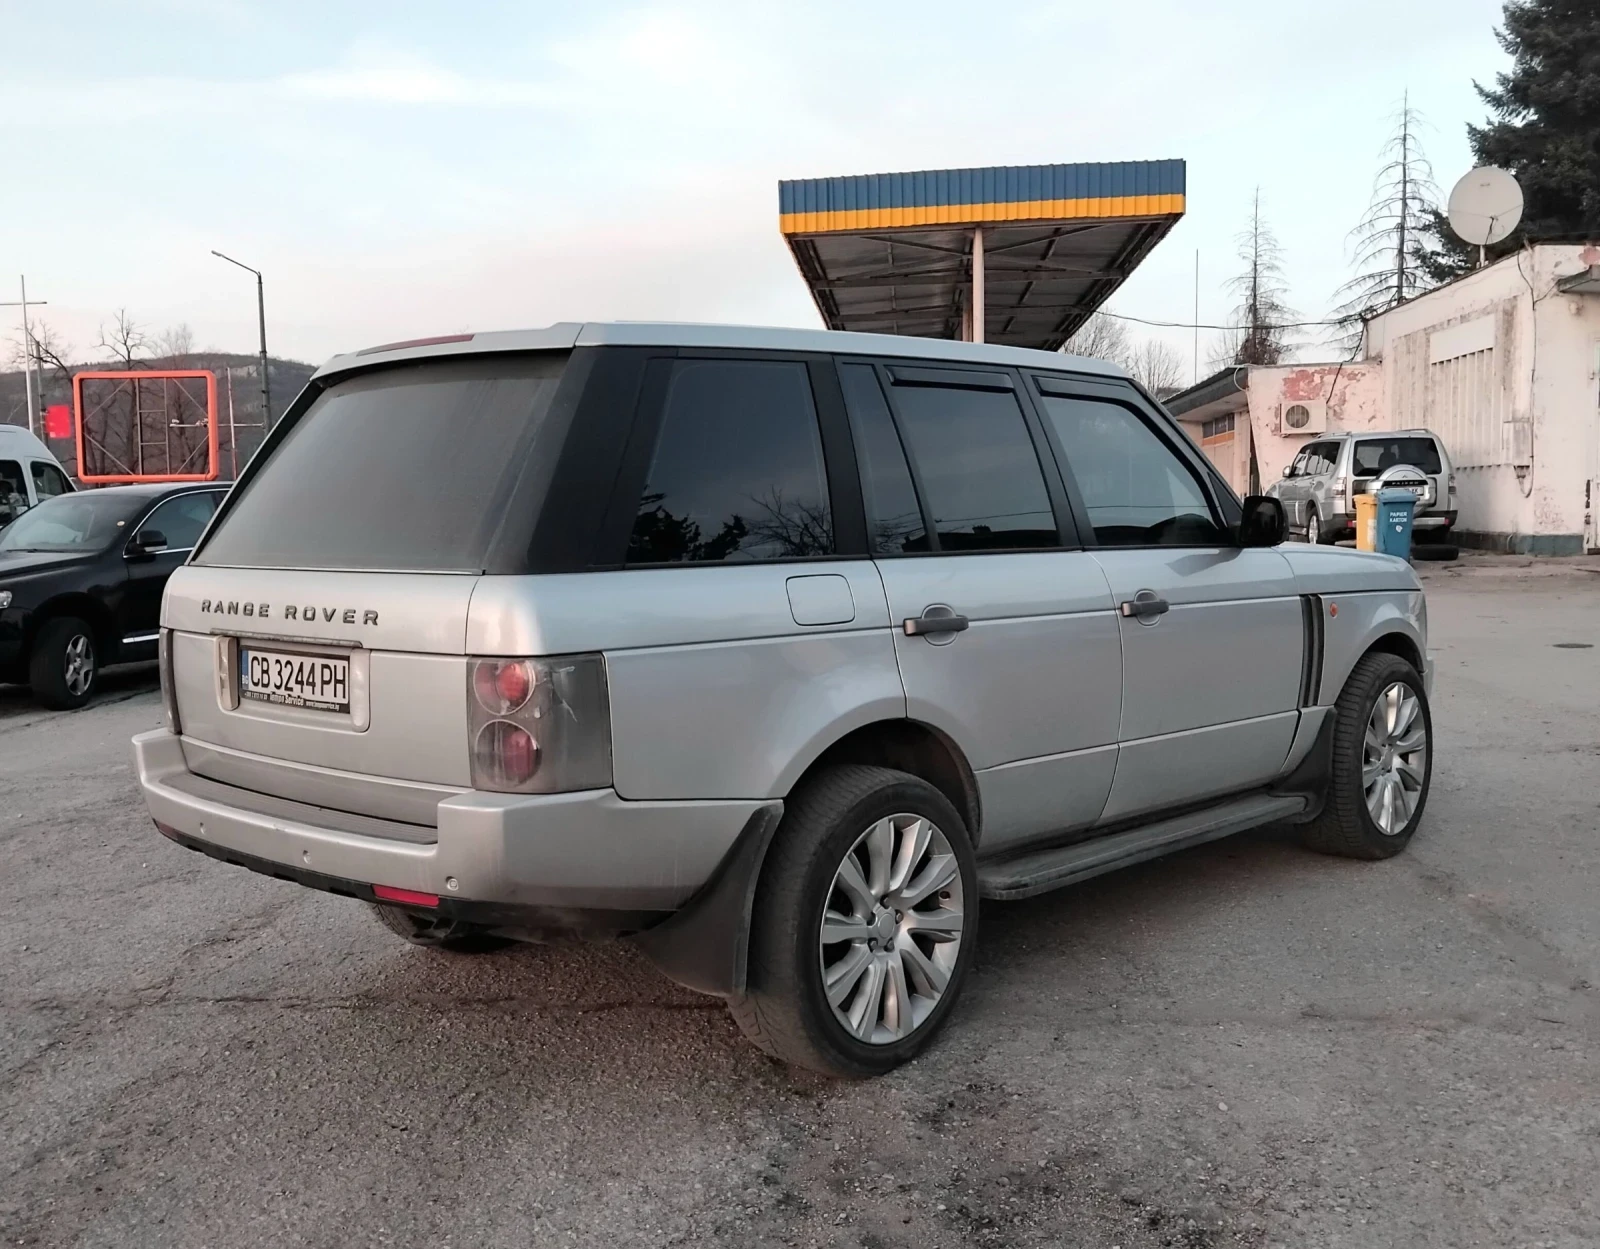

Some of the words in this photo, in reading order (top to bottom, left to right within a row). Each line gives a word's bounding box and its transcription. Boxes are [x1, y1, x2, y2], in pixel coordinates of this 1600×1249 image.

[201, 599, 270, 618] RANGE
[284, 605, 379, 626] ROVER
[285, 694, 304, 707] Service
